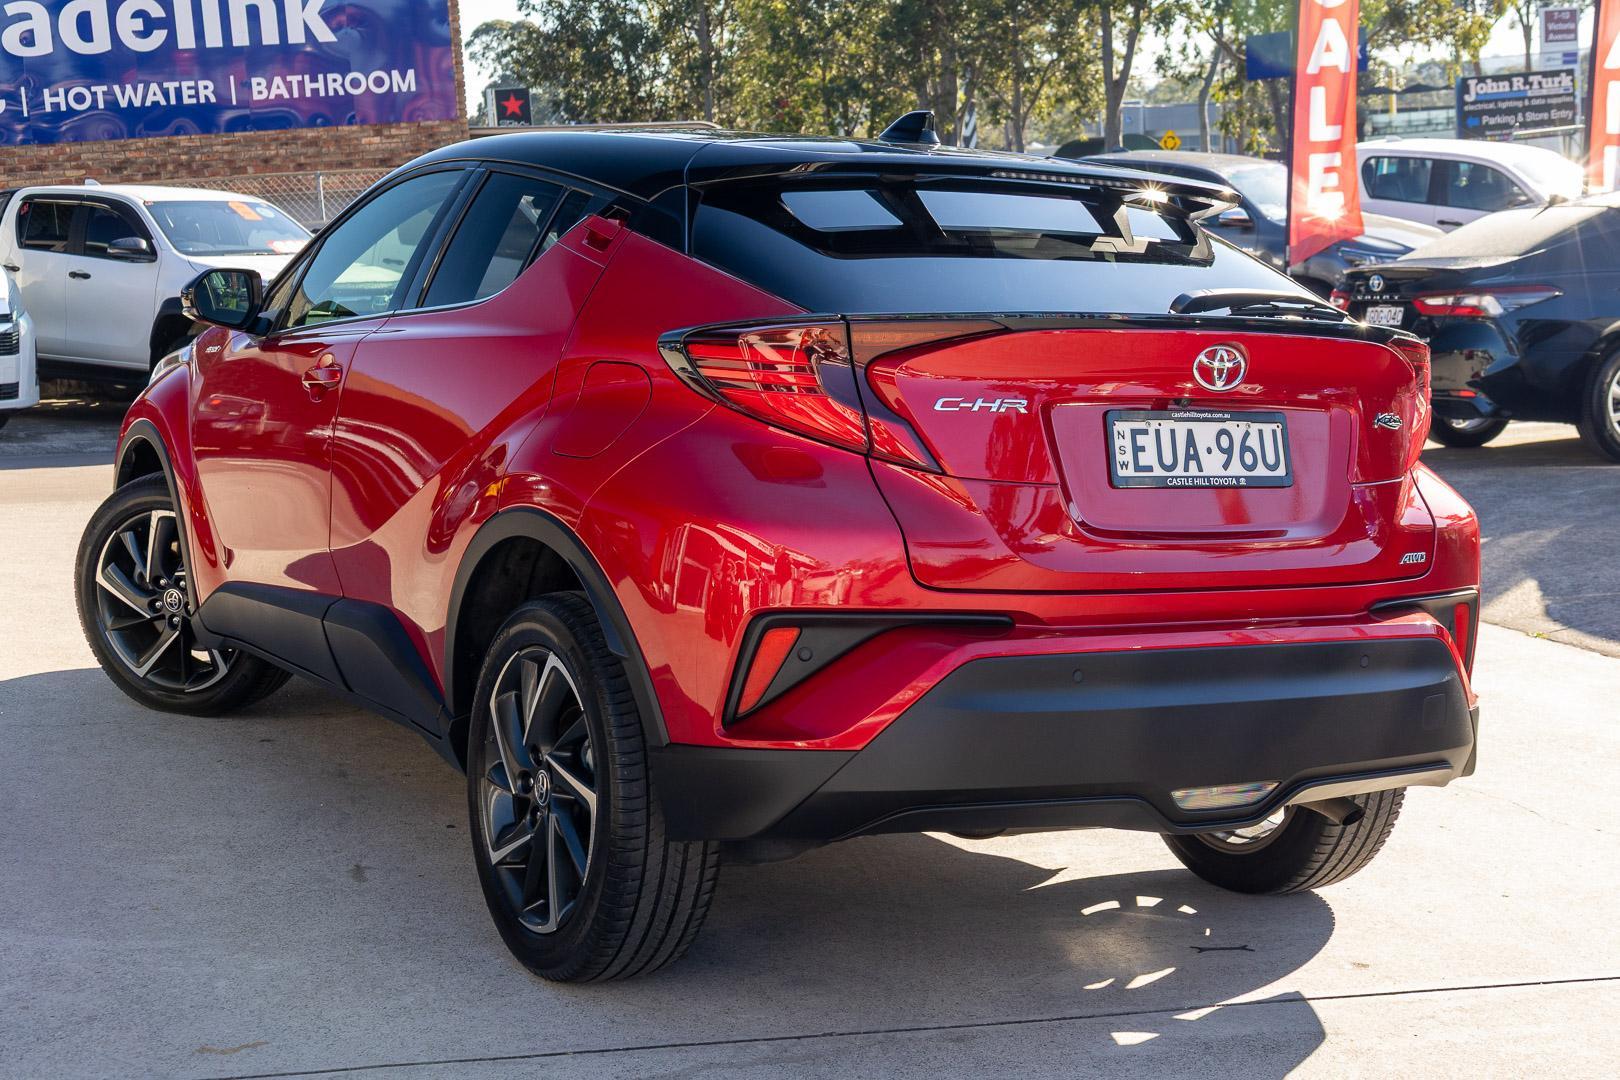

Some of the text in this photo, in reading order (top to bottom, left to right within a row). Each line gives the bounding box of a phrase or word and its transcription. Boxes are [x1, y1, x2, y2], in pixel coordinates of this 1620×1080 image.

[250, 68, 416, 101] BATHROOM
[1463, 78, 1510, 102] John
[43, 79, 217, 112] HOT WATER
[1306, 0, 1351, 214] ALE
[1482, 108, 1574, 126] Parking & Store Entry
[934, 397, 1028, 414] C-HR
[1171, 411, 1231, 420] castlehilltoyota.com.au
[1167, 477, 1237, 486] CASTLE HILL TOYOTA
